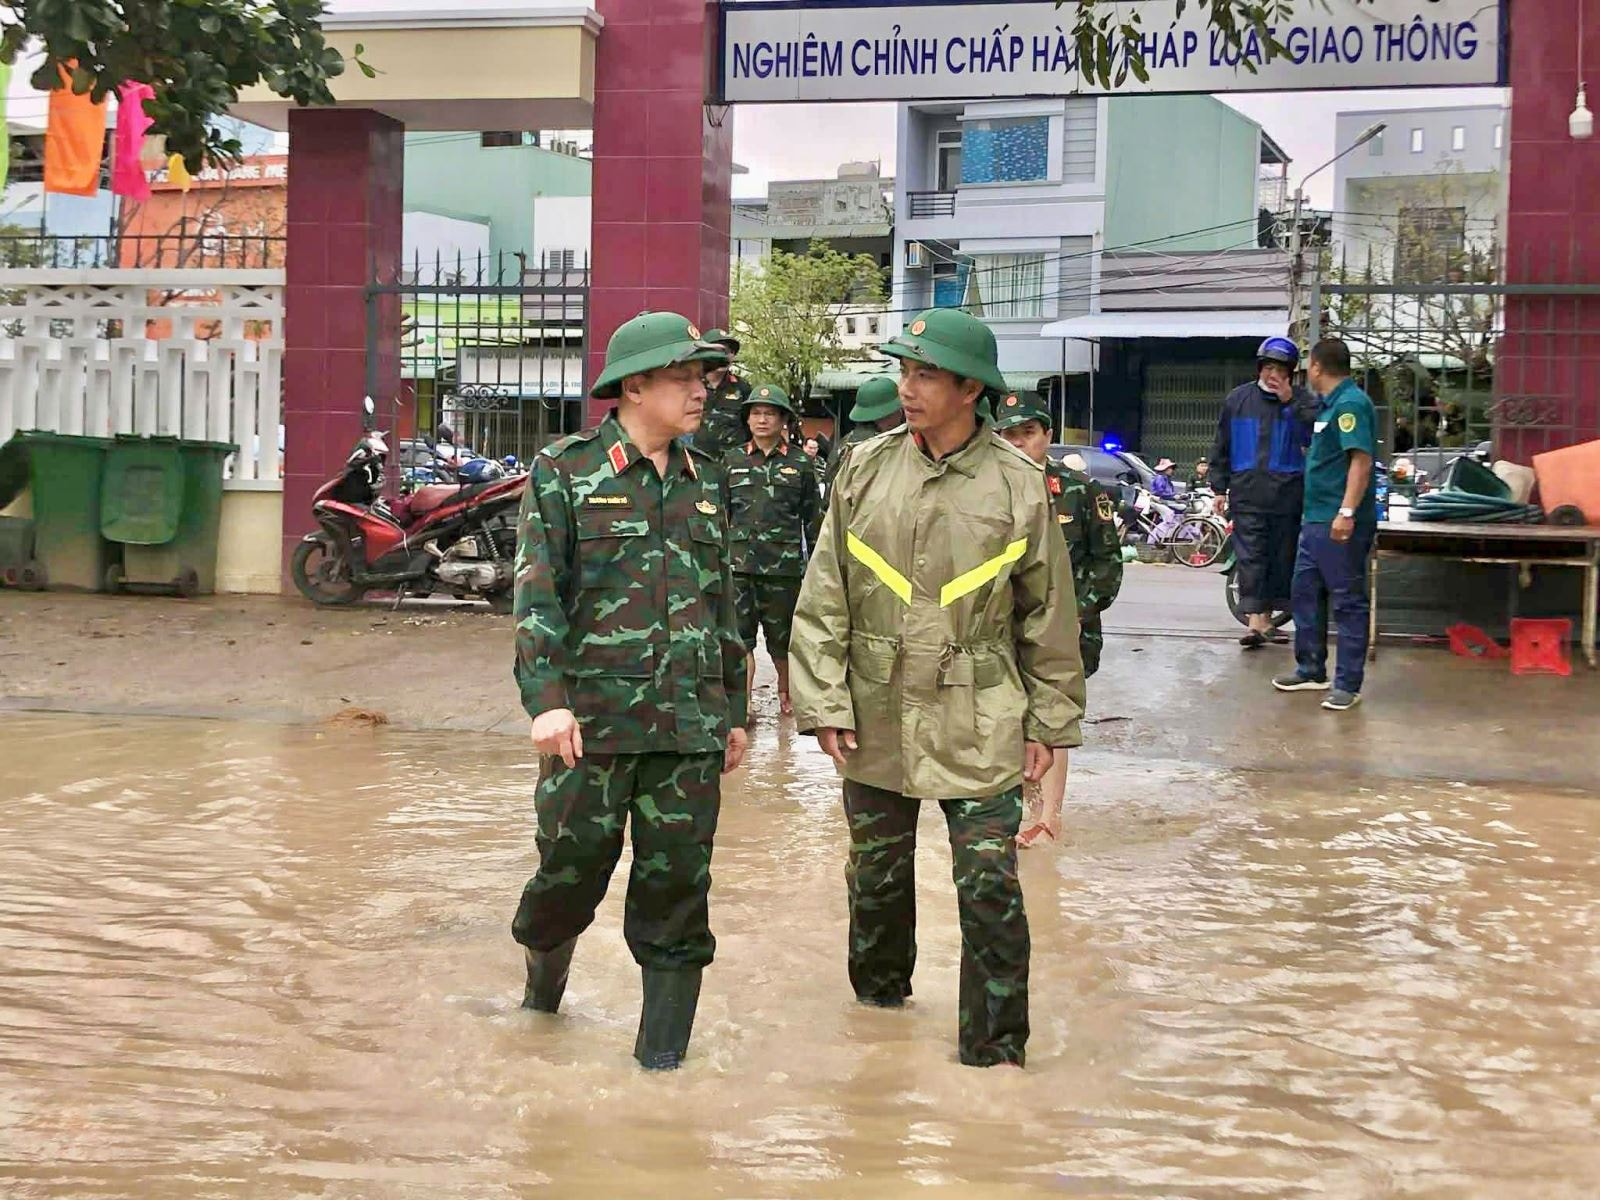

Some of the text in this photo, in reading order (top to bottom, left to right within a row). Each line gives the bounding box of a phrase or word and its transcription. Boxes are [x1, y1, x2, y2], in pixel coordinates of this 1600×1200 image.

[733, 32, 843, 79] NGHIÊM
[851, 24, 938, 76] CHỈNH
[945, 23, 1025, 74] CHẤP
[1032, 26, 1113, 72] HÀ
[1286, 25, 1364, 65] GIAO
[1374, 14, 1479, 63] THÔNG
